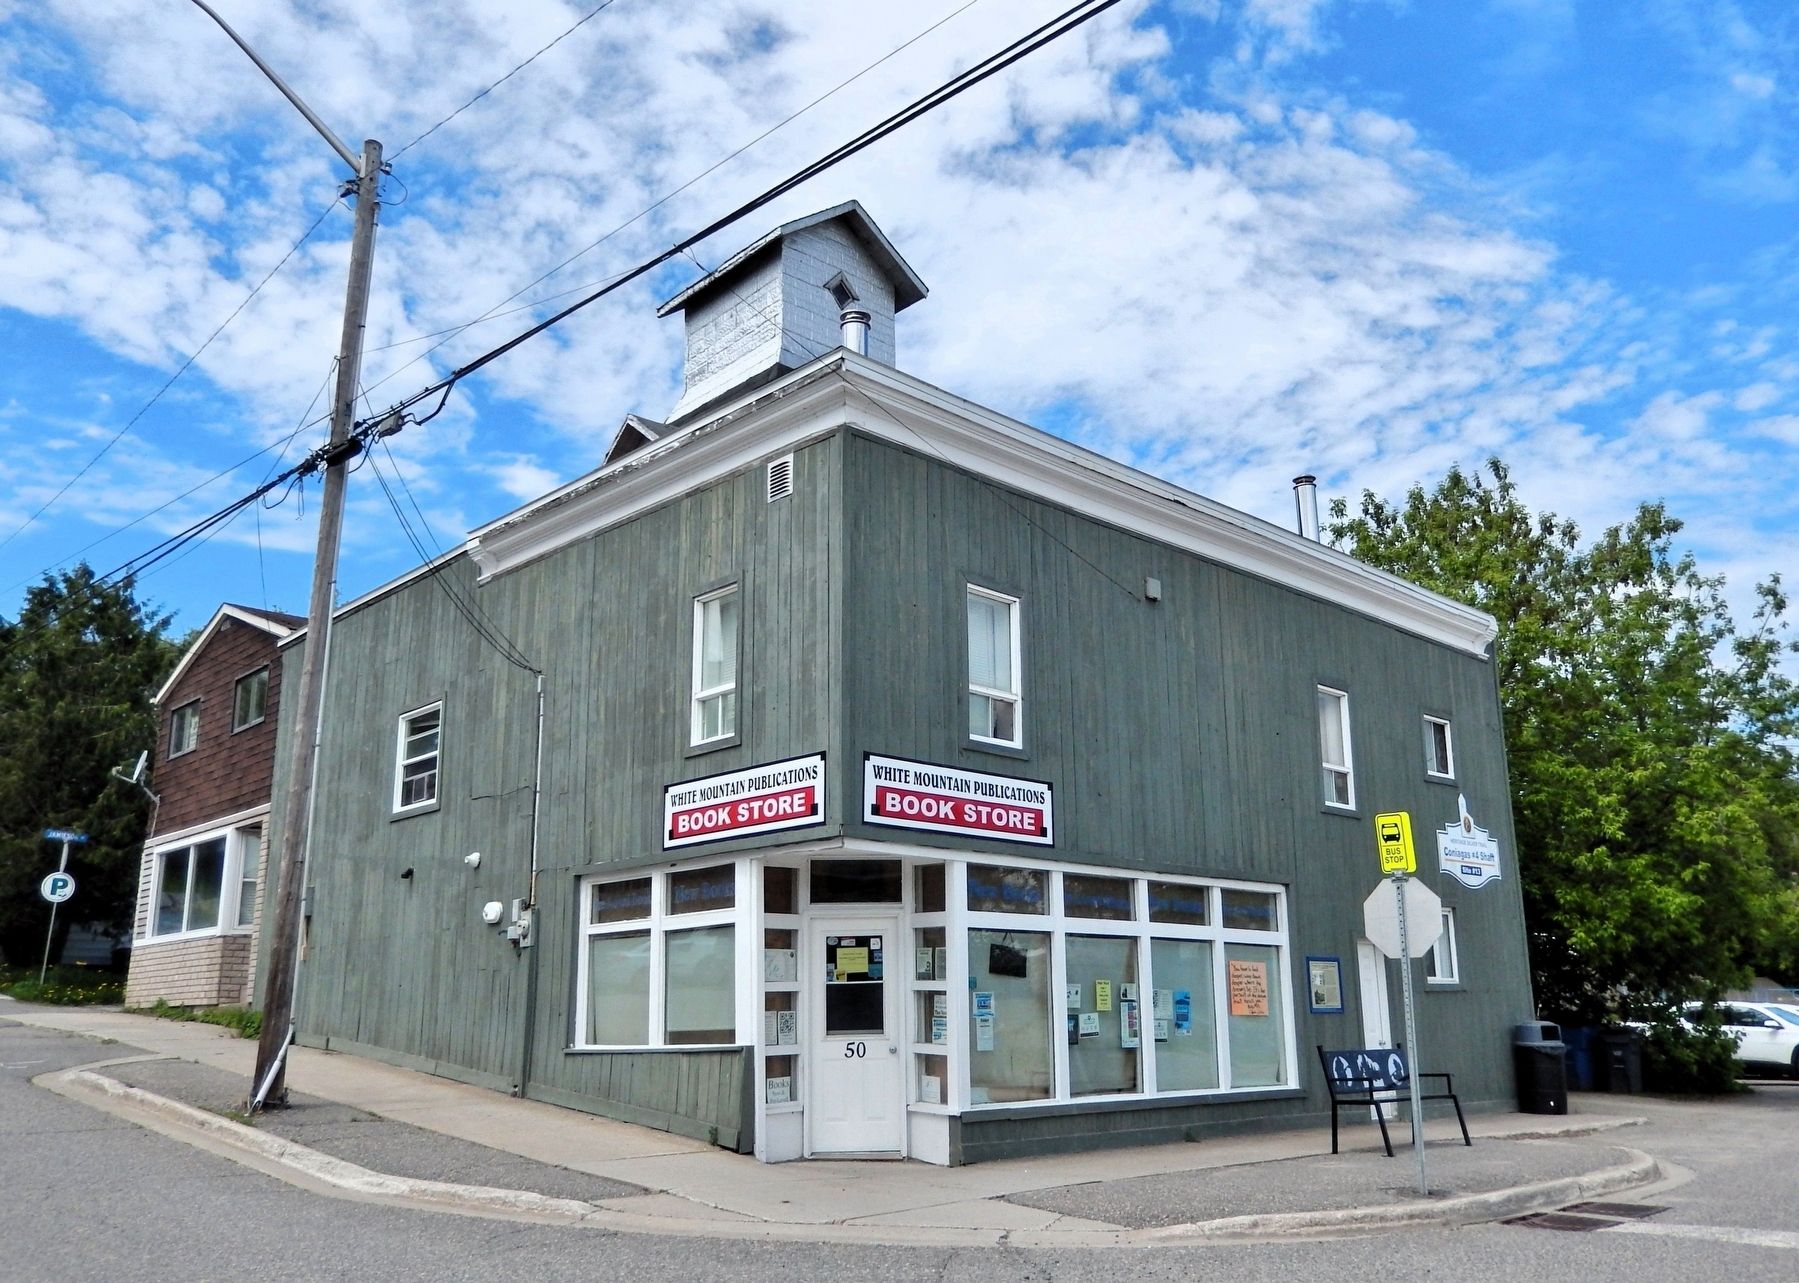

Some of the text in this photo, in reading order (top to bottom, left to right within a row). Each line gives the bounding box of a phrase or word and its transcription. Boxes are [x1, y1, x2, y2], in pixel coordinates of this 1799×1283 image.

[670, 765, 819, 808] WHITE MOUNTAIN PUBLICATIONS
[872, 764, 1046, 805] WHITE MOUNTAIN PUBLICATIONS
[677, 792, 806, 833] BOOK STORE
[885, 792, 1036, 831] BOOK STORE
[1386, 847, 1402, 855] BUS
[1444, 846, 1471, 860] Coniagas
[1385, 856, 1404, 864] STOP
[50, 878, 69, 896] P
[844, 1042, 866, 1058] 50
[768, 1079, 790, 1090] Books
